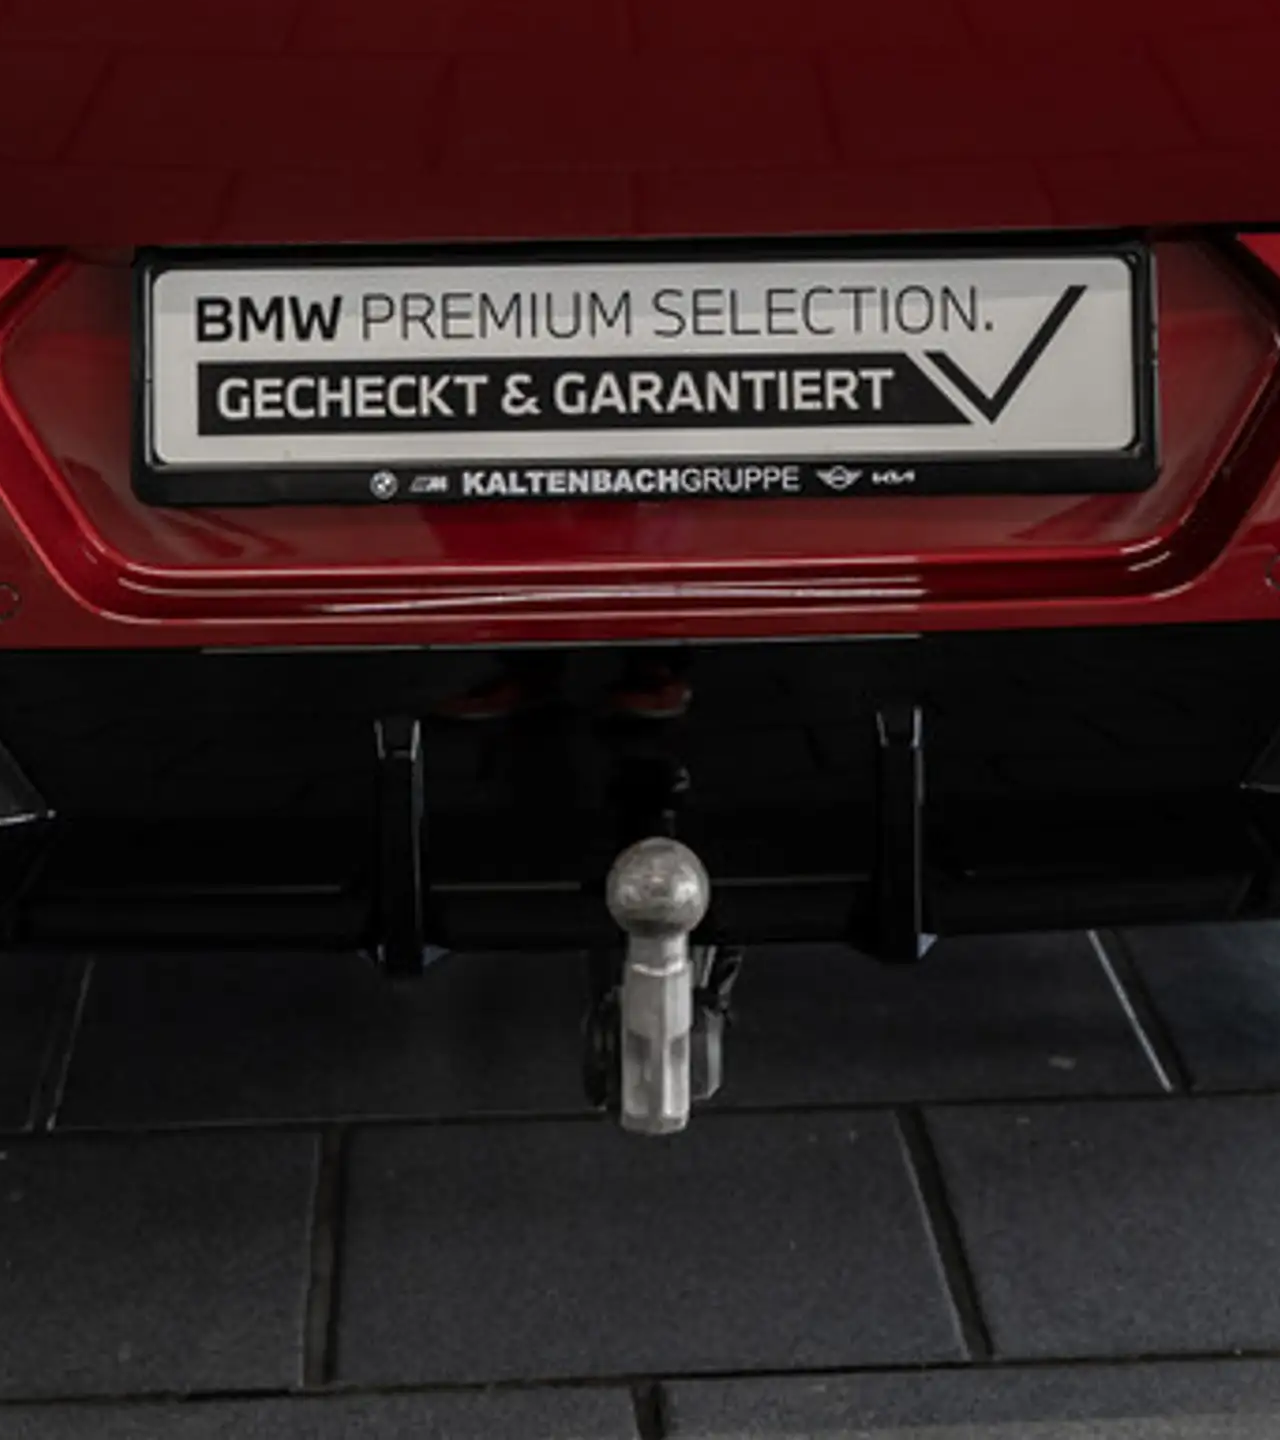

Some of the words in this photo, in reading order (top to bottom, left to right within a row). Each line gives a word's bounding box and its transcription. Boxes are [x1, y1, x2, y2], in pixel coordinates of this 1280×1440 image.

[195, 295, 342, 343] BMW
[362, 291, 632, 340] PREMIUM
[652, 285, 995, 338] SELECTION.
[217, 375, 488, 420] GECHECKT
[501, 374, 541, 415] &
[553, 368, 895, 415] GARANTIERT
[462, 465, 801, 496] KALTENBACHGRUPPE
